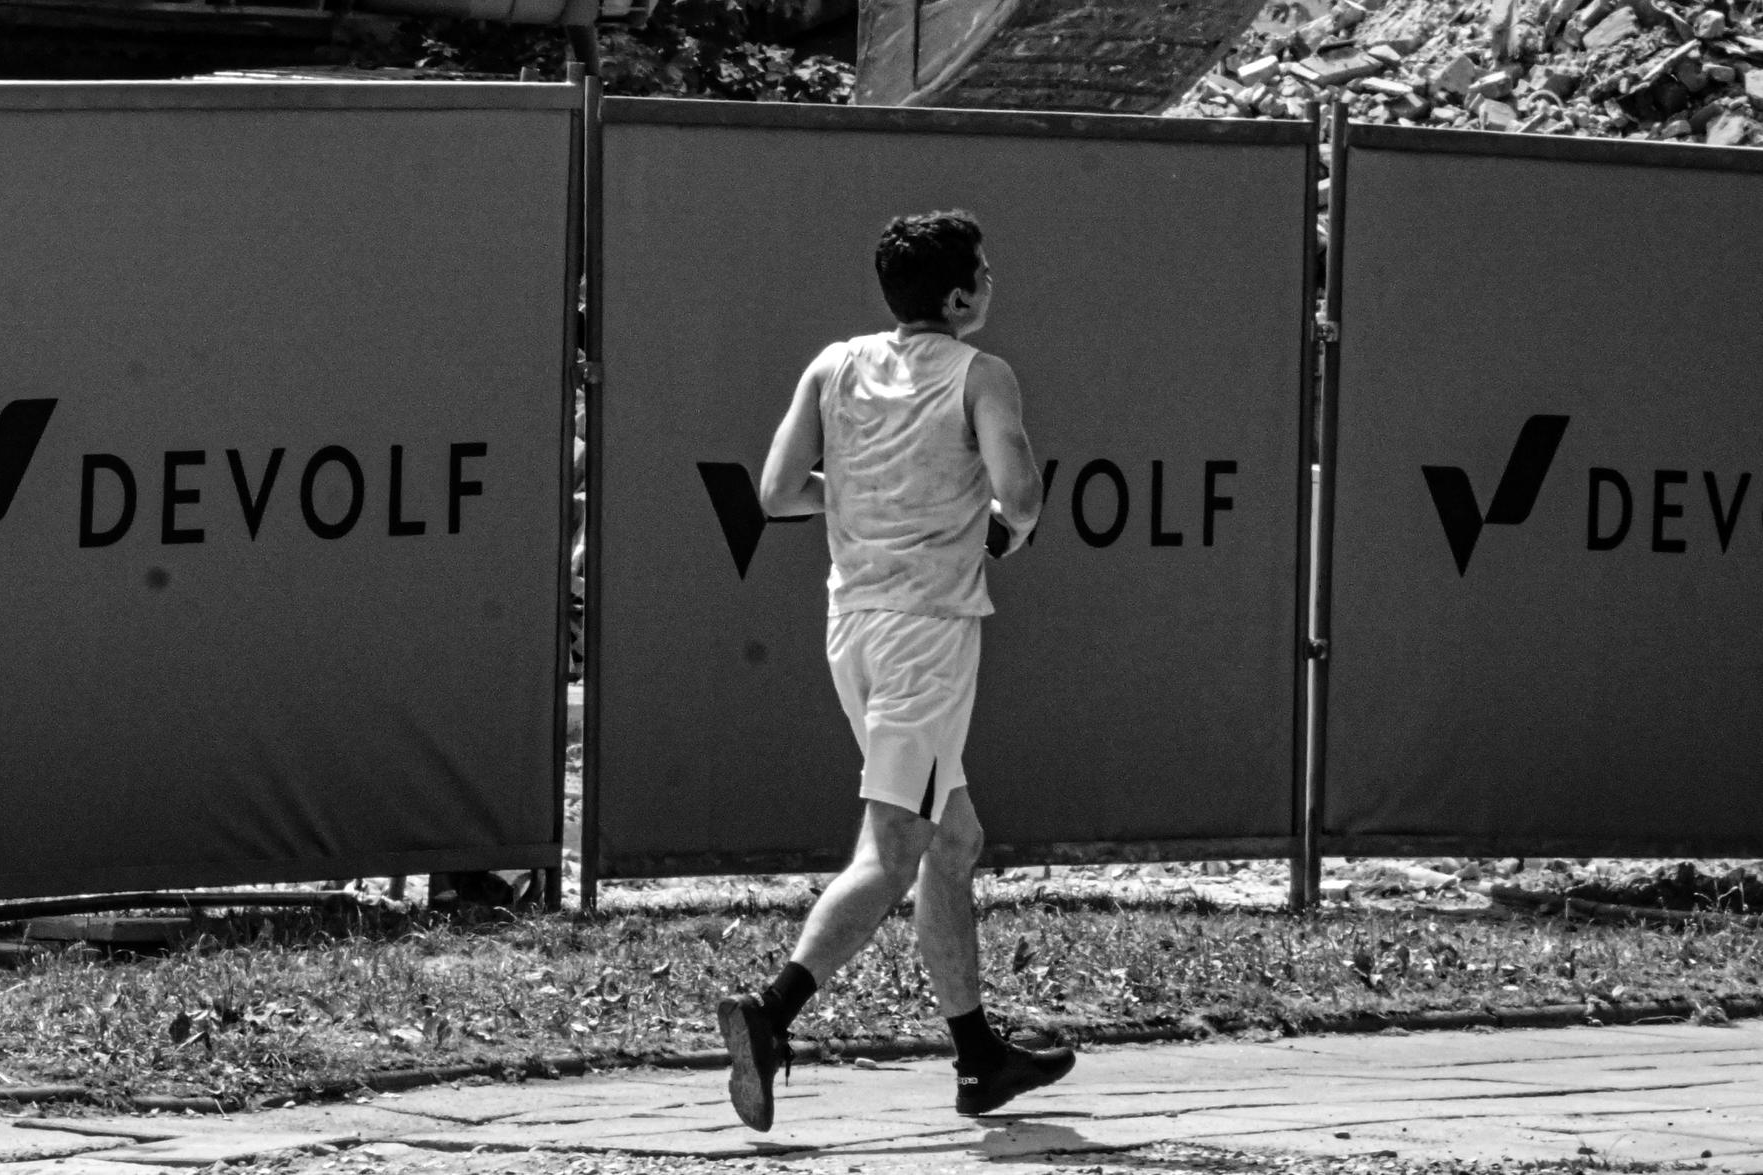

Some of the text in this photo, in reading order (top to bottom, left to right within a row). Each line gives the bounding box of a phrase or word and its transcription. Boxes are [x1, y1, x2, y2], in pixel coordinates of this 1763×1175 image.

[79, 442, 488, 548] DEVOLF
[1026, 459, 1238, 549] OLF
[1586, 466, 1763, 555] DEV
